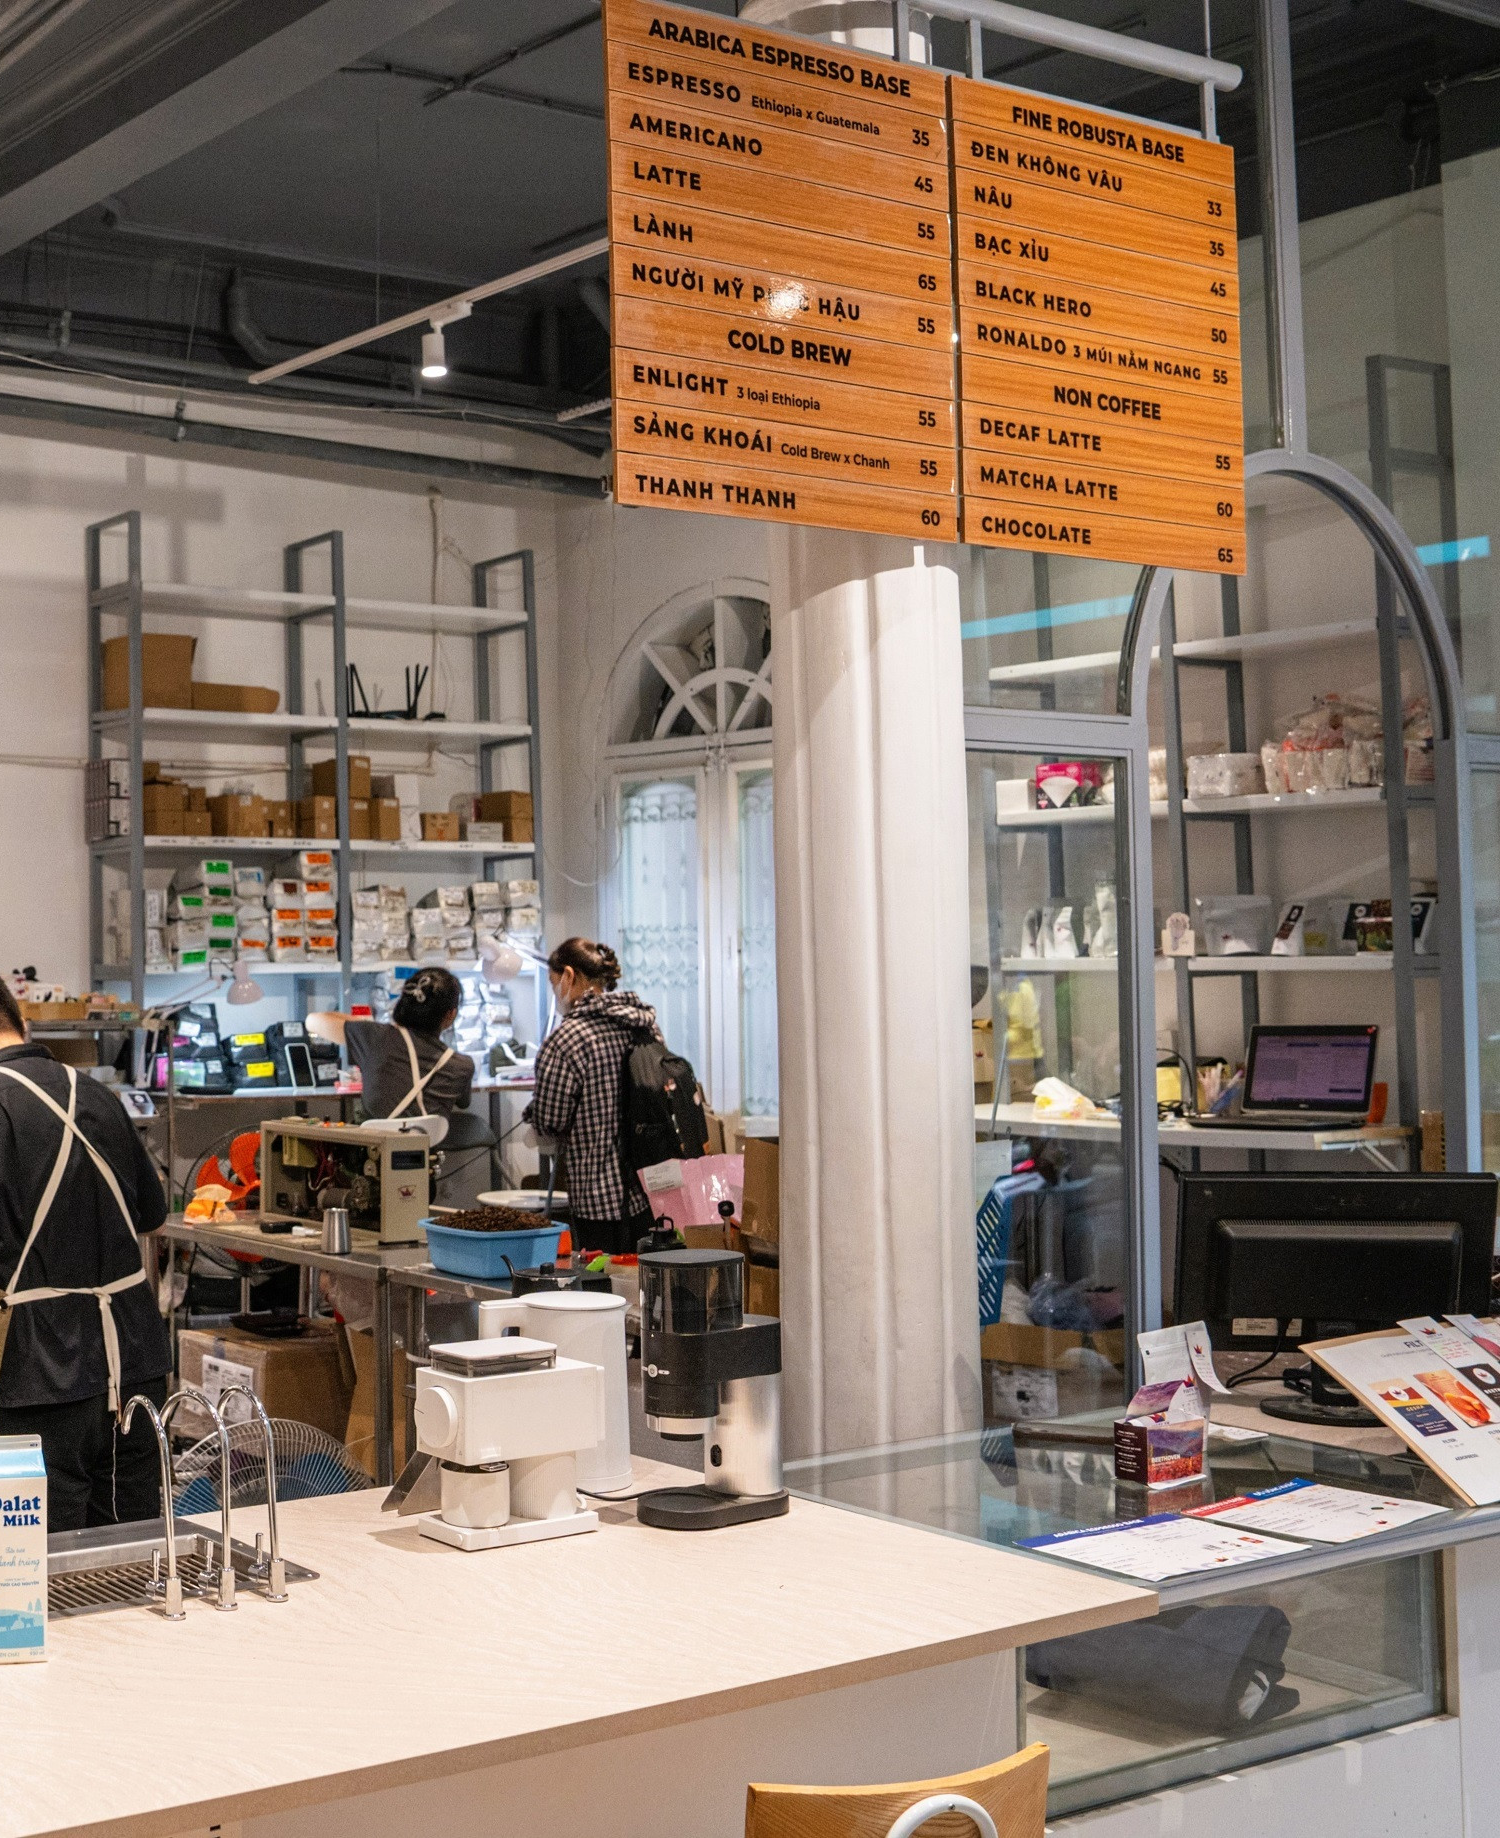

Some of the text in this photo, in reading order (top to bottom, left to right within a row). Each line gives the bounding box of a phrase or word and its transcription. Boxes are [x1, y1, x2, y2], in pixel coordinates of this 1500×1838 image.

[649, 18, 911, 97] ARABICA ESPRESSO BASE
[628, 62, 930, 146] ESPRESSO Ethiopia x Guatemala 35
[1013, 107, 1185, 163] FINE ROBUSTA BASE
[629, 113, 934, 193] AMERICANO 45
[971, 141, 1222, 217] ĐEN KHÔNG VÂU 33
[633, 162, 935, 240] LATTE 55
[974, 185, 1225, 257] NÂU 35
[633, 213, 937, 291] LÀNH 65
[975, 232, 1227, 297] BẠC XỈU 45
[632, 263, 935, 335] NGƯỜI MỸ PC HẬU 55
[976, 280, 1227, 344] BLACK HERO 50
[728, 330, 852, 367] COLD BREW
[978, 324, 1067, 355] RONALDO
[1073, 346, 1081, 358] 3
[1087, 345, 1112, 364] MÚI
[1154, 361, 1201, 380] NGANG
[1213, 369, 1228, 385] 55
[633, 364, 936, 428] ENLIGHT 3 loại Ethiopia 55
[1054, 386, 1161, 421] NON COFFEE
[633, 412, 938, 477] SẢNG KHOÁI Cold Brew x Chanh 55
[980, 418, 1231, 470] DECAF LATTE 55
[635, 474, 941, 527] THANH THANH 60
[980, 466, 1233, 517] MATCHA LATTE 60
[981, 516, 1234, 563] CHOCOLATE 65
[1151, 1453, 1181, 1463] BEETHOVEN
[3, 1514, 41, 1527] Milk
